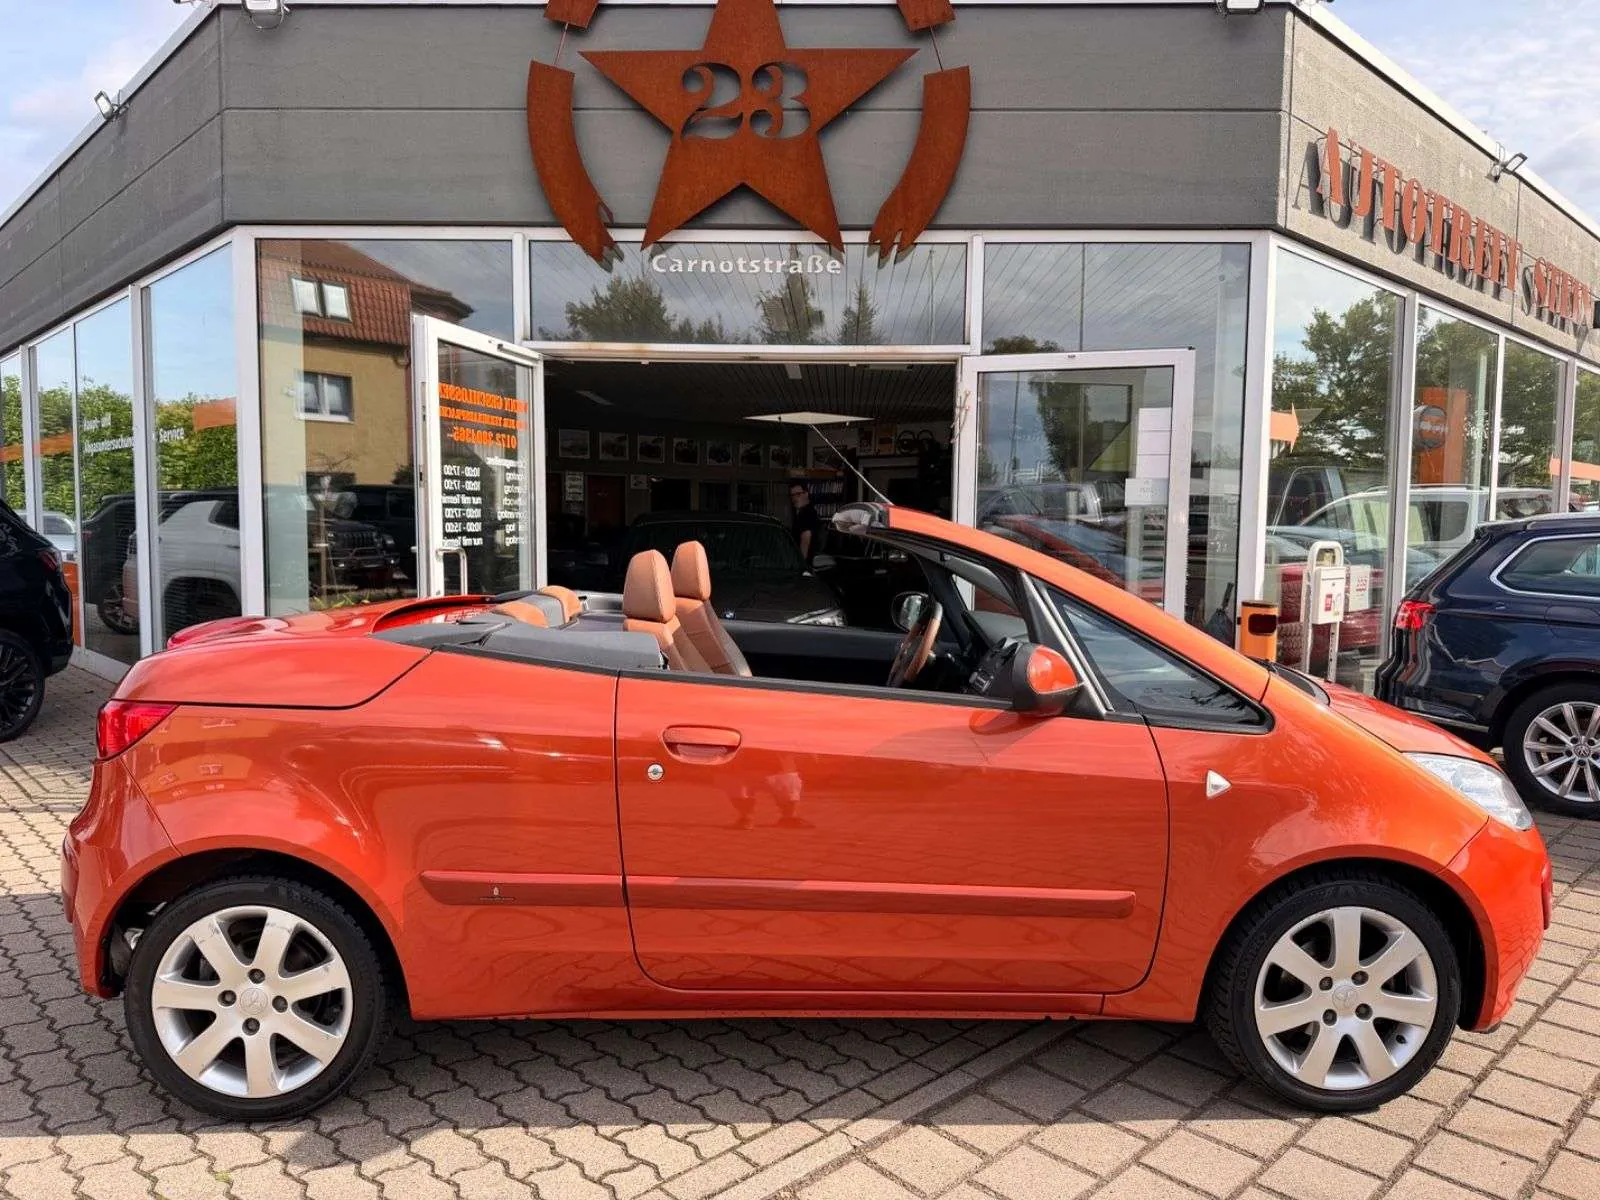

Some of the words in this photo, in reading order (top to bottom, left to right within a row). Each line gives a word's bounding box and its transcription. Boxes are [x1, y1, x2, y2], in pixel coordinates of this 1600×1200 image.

[680, 61, 811, 141] 23
[651, 254, 842, 276] Carnotstraße
[159, 427, 185, 443] Service
